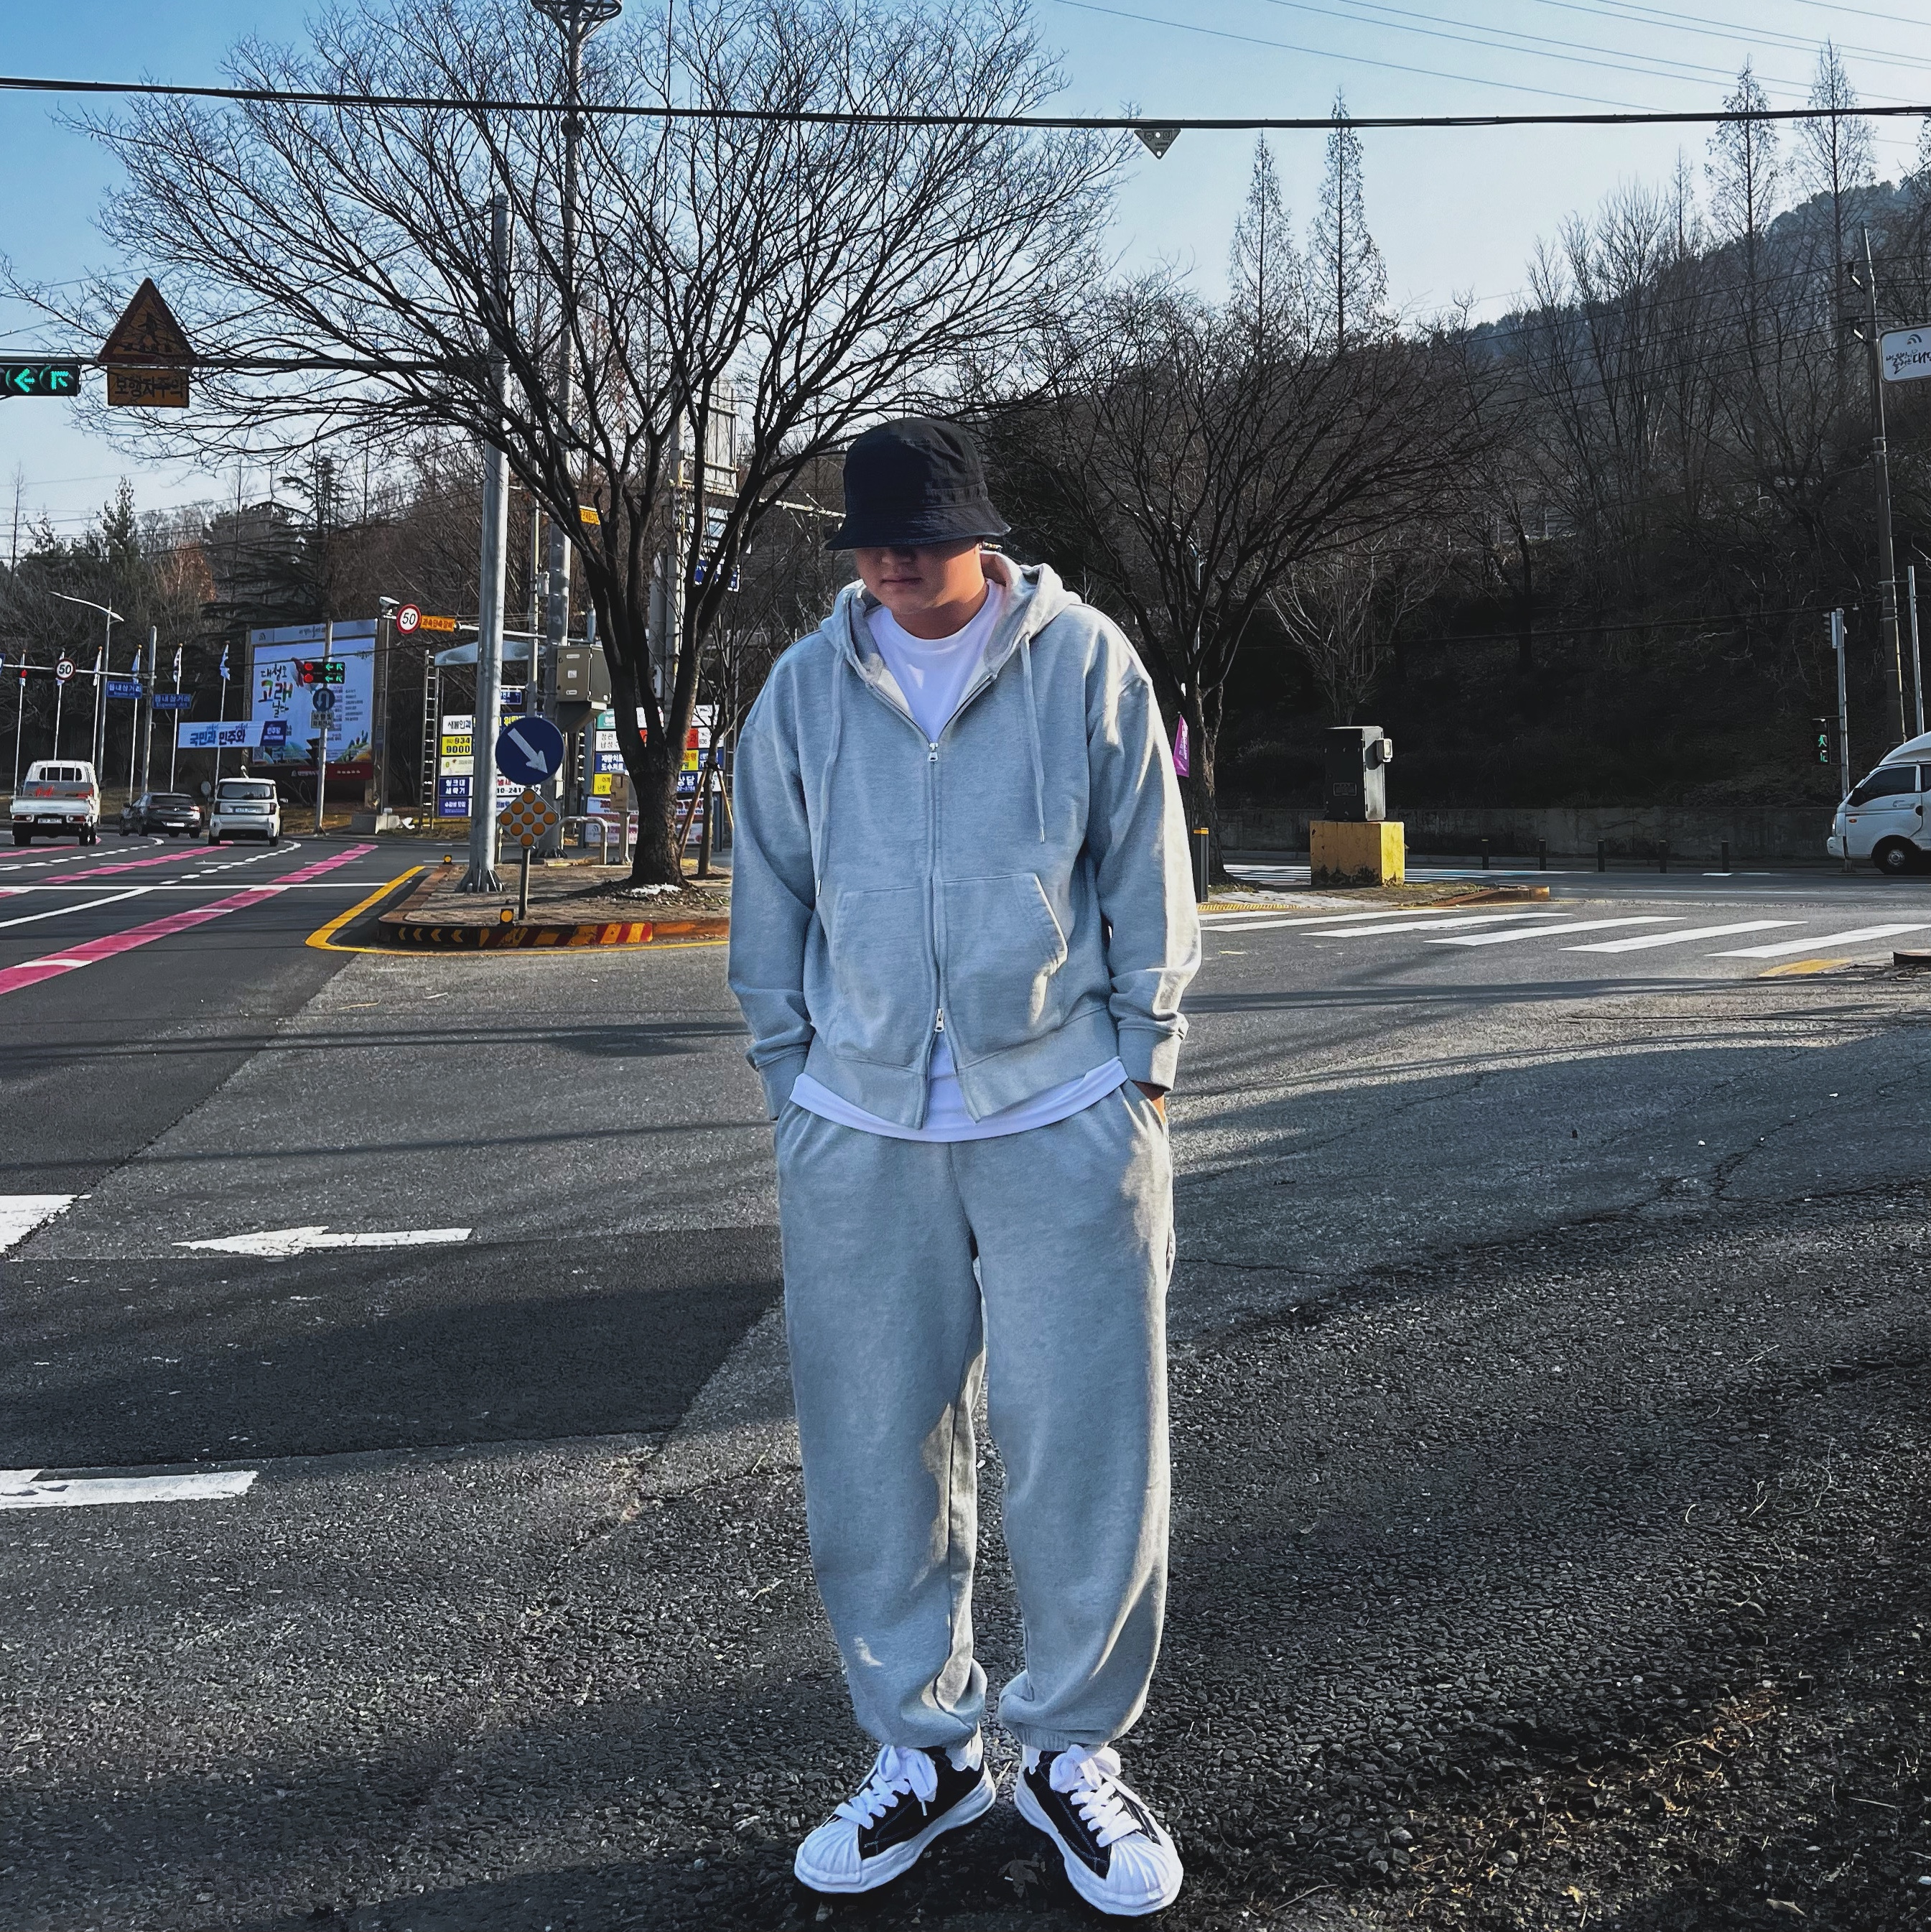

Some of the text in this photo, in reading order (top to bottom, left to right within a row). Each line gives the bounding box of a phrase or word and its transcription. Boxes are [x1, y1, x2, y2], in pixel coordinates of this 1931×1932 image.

[402, 612, 417, 626] 50
[58, 664, 72, 674] 50
[258, 679, 294, 703] 고래
[190, 728, 246, 746] 국민과 민주와
